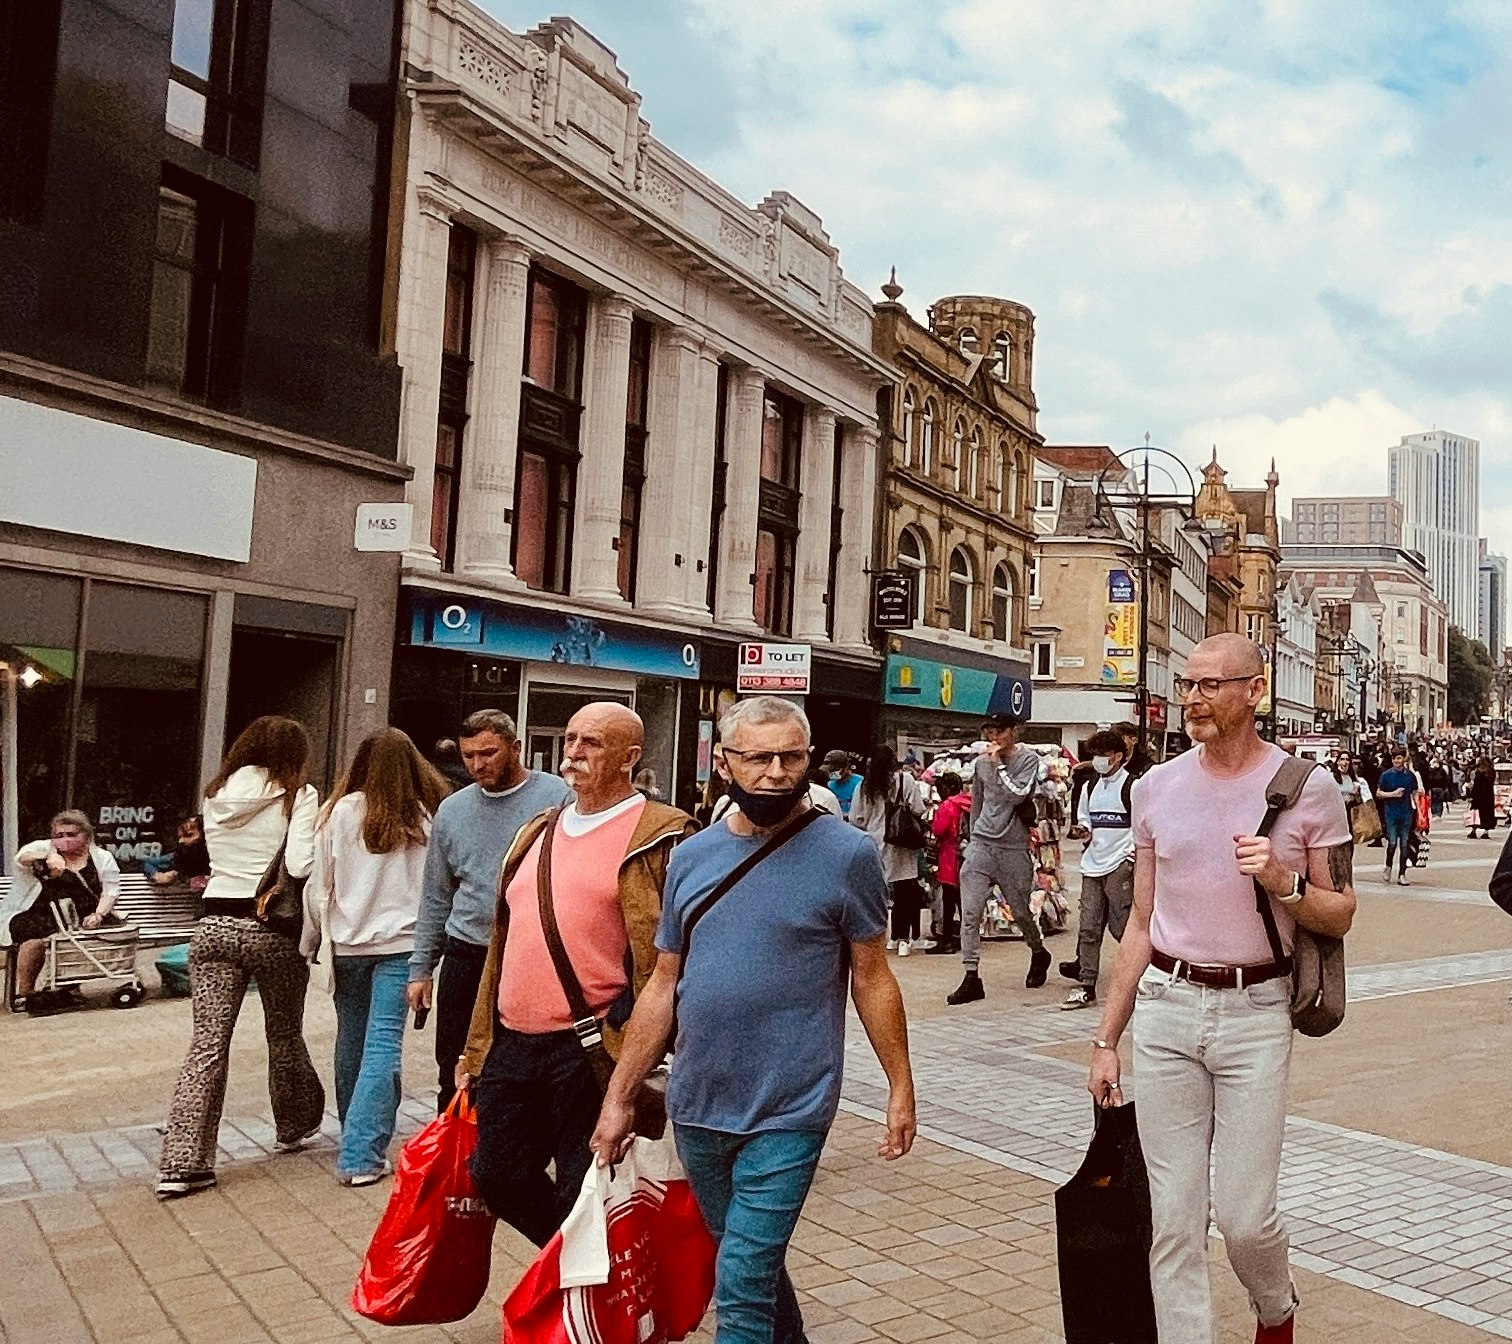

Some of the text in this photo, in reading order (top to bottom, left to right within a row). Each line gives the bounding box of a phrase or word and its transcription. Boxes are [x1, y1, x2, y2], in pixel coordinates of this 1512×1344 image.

[367, 517, 397, 530] M&S
[767, 652, 783, 662] TO
[785, 652, 805, 662] LET
[115, 826, 138, 840] ON
